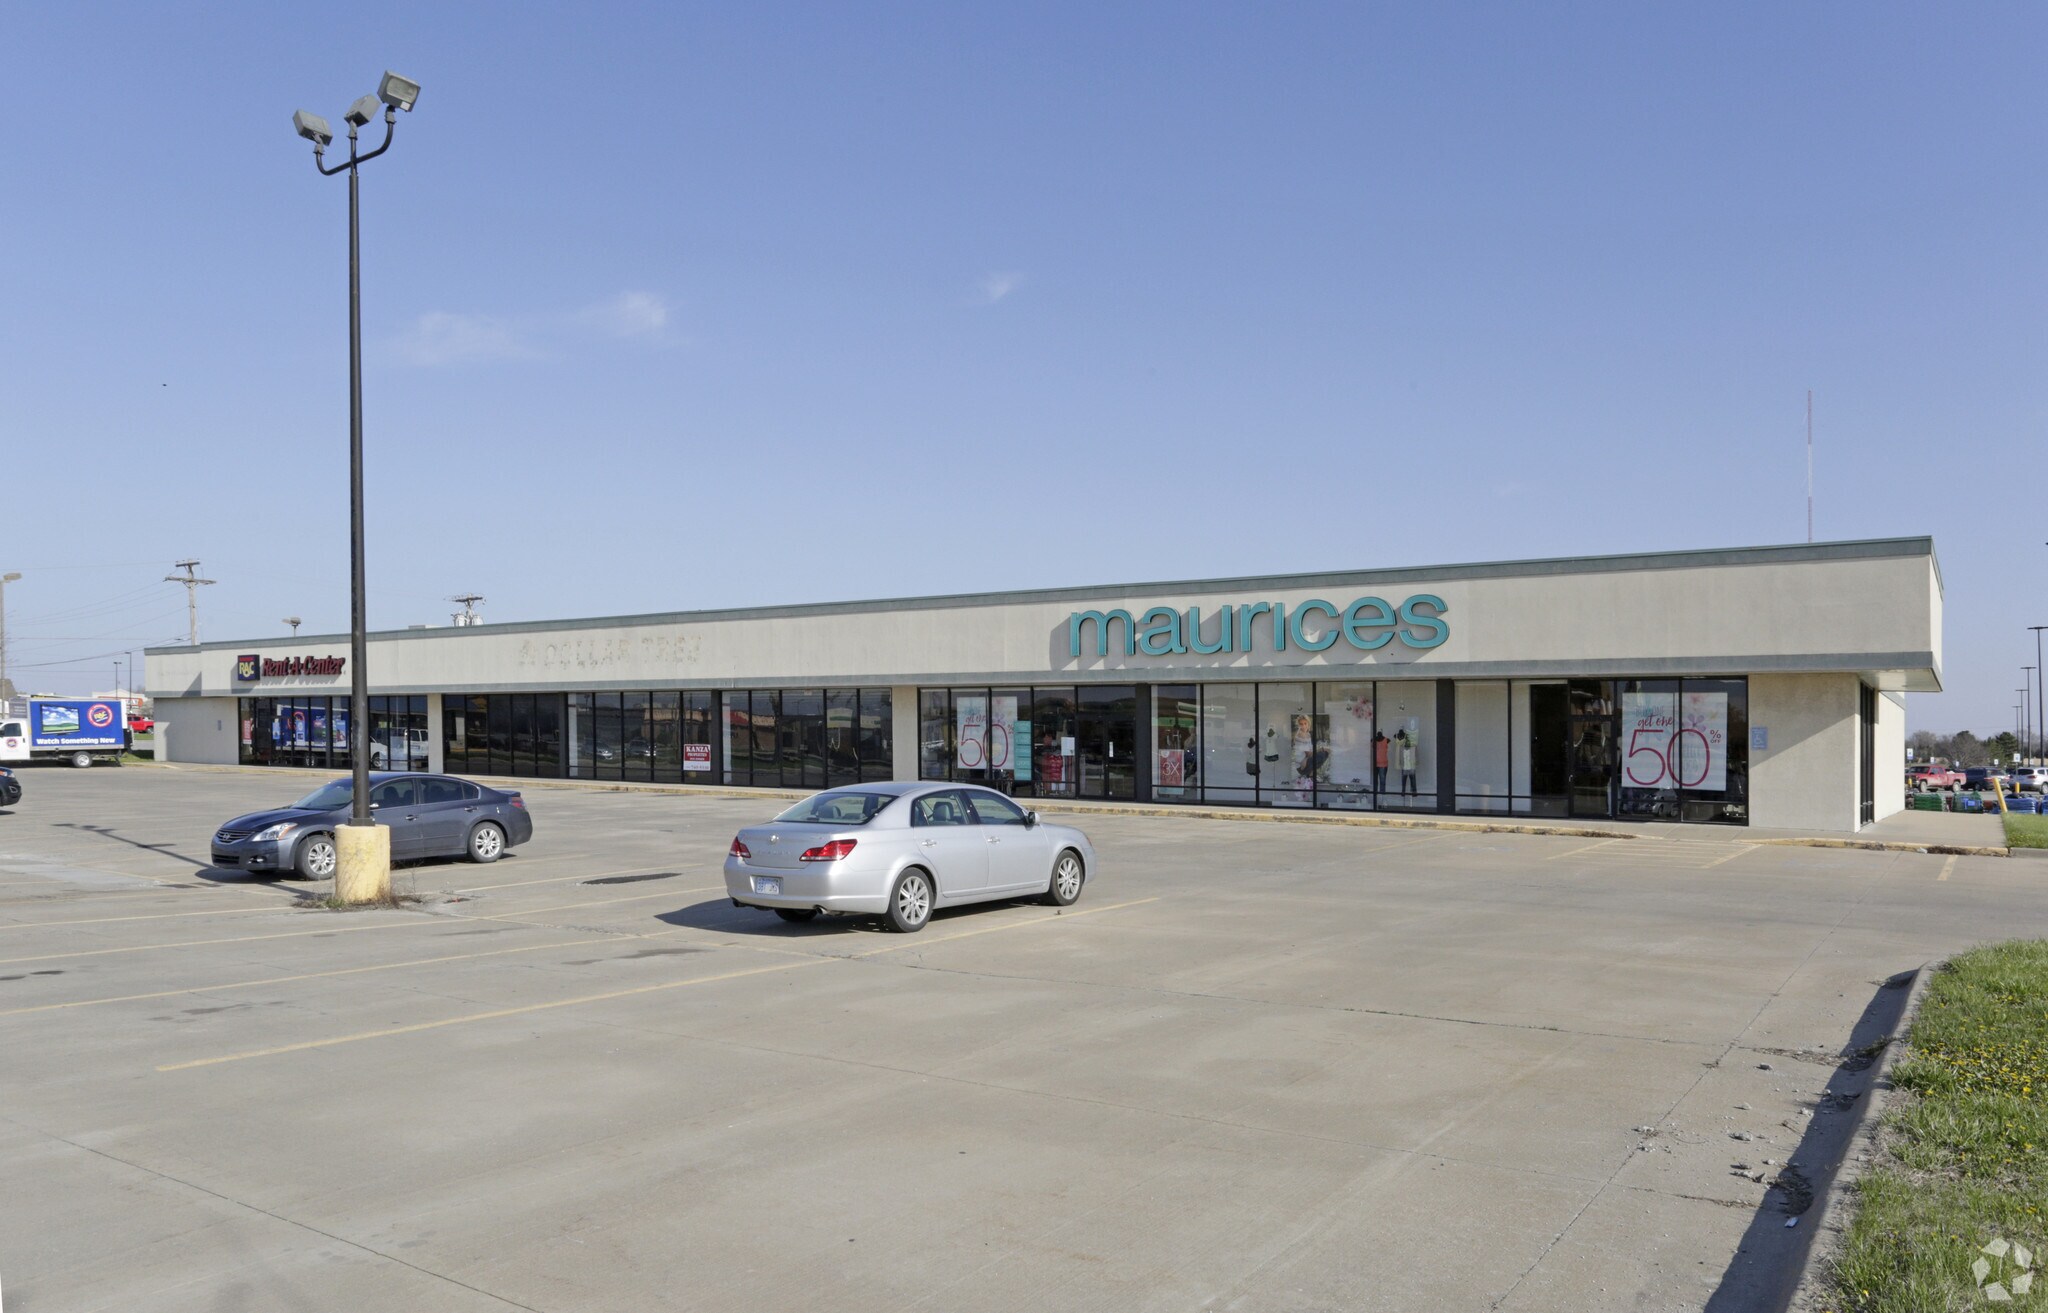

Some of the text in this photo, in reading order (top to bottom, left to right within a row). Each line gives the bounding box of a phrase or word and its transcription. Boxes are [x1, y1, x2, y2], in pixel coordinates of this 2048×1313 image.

[1069, 593, 1451, 658] maurices
[239, 661, 255, 678] RAC
[1637, 712, 1673, 735] get one
[61, 737, 99, 745] Something
[960, 723, 1009, 768] 50
[1162, 761, 1180, 776] 3X
[1626, 728, 1711, 787] 50
